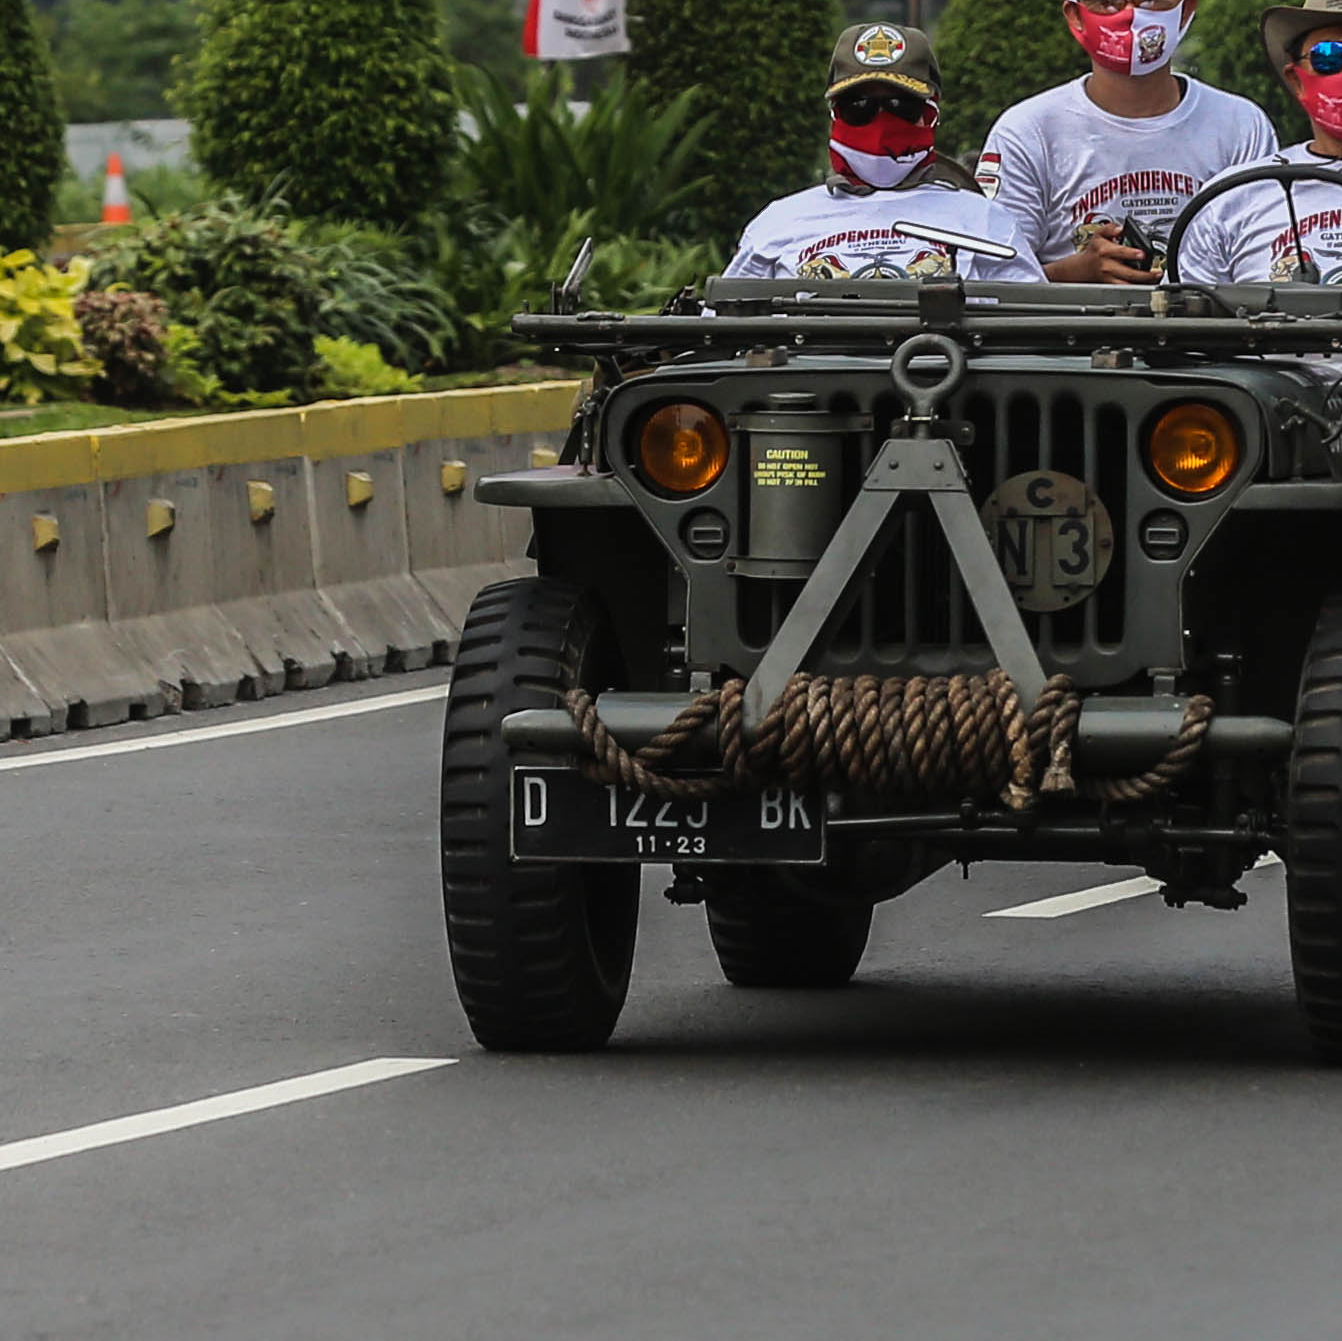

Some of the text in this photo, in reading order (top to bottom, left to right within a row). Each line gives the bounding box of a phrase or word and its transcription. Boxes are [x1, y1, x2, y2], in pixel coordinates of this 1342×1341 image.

[1071, 170, 1195, 225] INDEPENDENCE
[1121, 197, 1179, 208] GATHERING
[766, 449, 808, 460] CAUTION
[1025, 477, 1055, 509] C
[1057, 520, 1090, 576] 3
[523, 776, 547, 827] D
